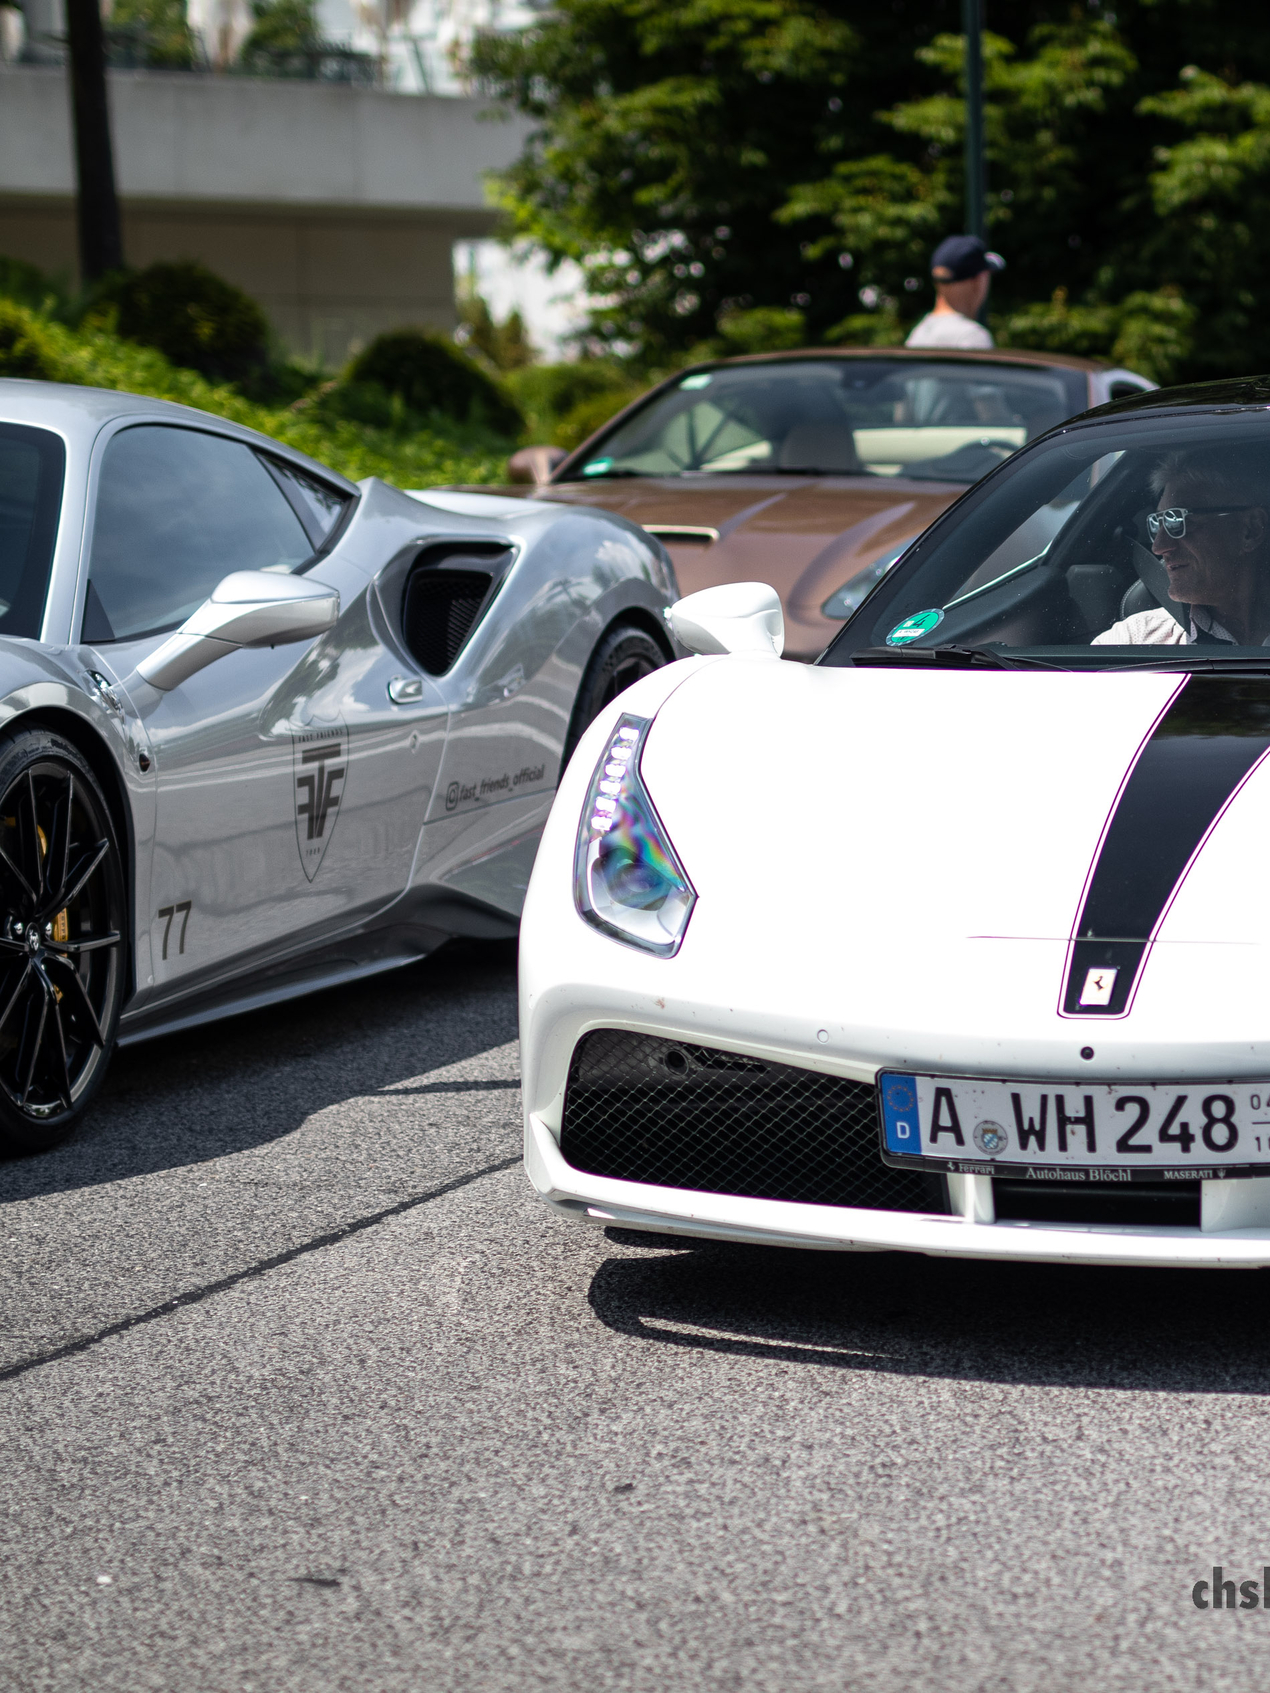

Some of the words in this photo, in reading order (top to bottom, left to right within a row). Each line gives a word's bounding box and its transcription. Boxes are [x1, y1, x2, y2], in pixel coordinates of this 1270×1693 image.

[912, 613, 931, 628] 4
[460, 763, 546, 802] fast_friends_official
[158, 900, 192, 961] 77
[929, 1086, 966, 1147] A
[1011, 1092, 1097, 1154] WH
[1114, 1093, 1239, 1154] 248
[896, 1122, 910, 1139] D
[958, 1163, 995, 1175] Ferrari
[1025, 1167, 1086, 1181] Autohaus
[1089, 1169, 1132, 1182] Blöchl
[1163, 1170, 1213, 1180] MASERATI
